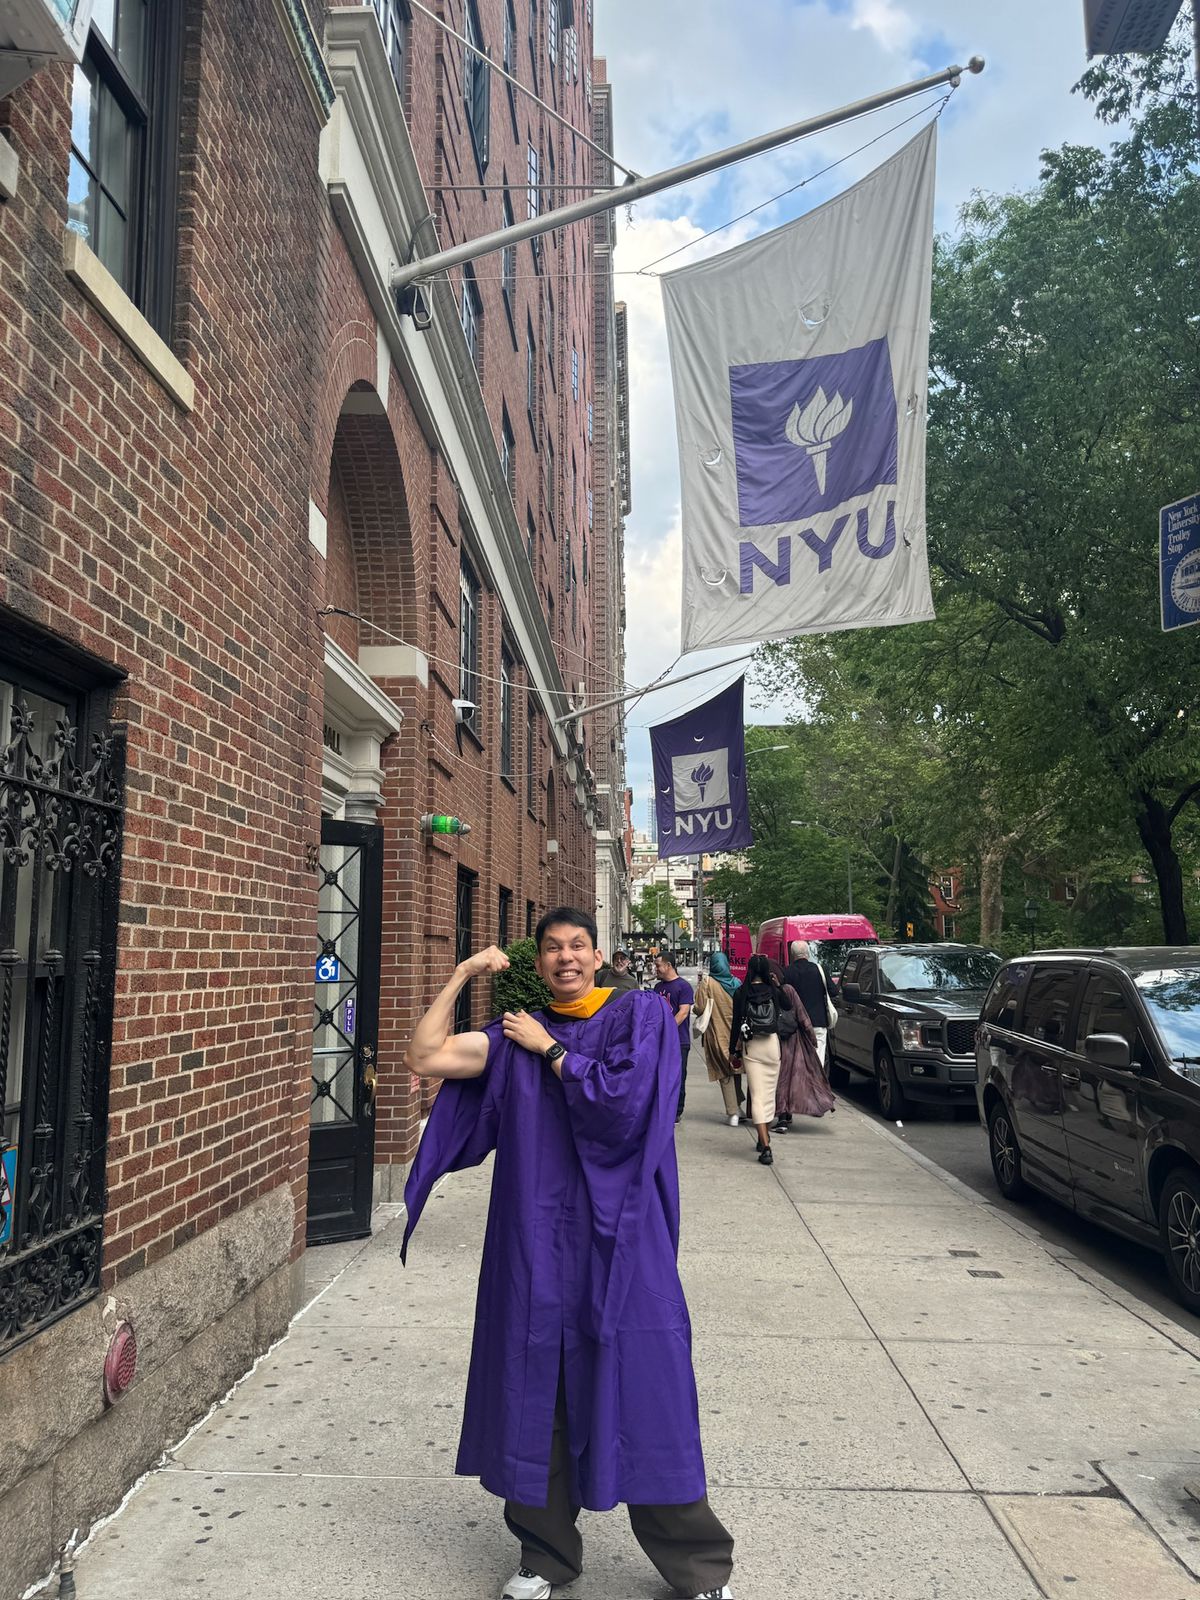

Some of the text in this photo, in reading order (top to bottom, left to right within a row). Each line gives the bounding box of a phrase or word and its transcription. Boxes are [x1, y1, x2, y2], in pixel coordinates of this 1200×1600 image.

[1168, 502, 1198, 521] New York
[1168, 513, 1200, 532] University
[739, 500, 896, 593] NYU
[1168, 530, 1191, 545] Trolley
[1168, 543, 1183, 555] Stop
[675, 808, 733, 837] NYU
[729, 957, 746, 966] AKE
